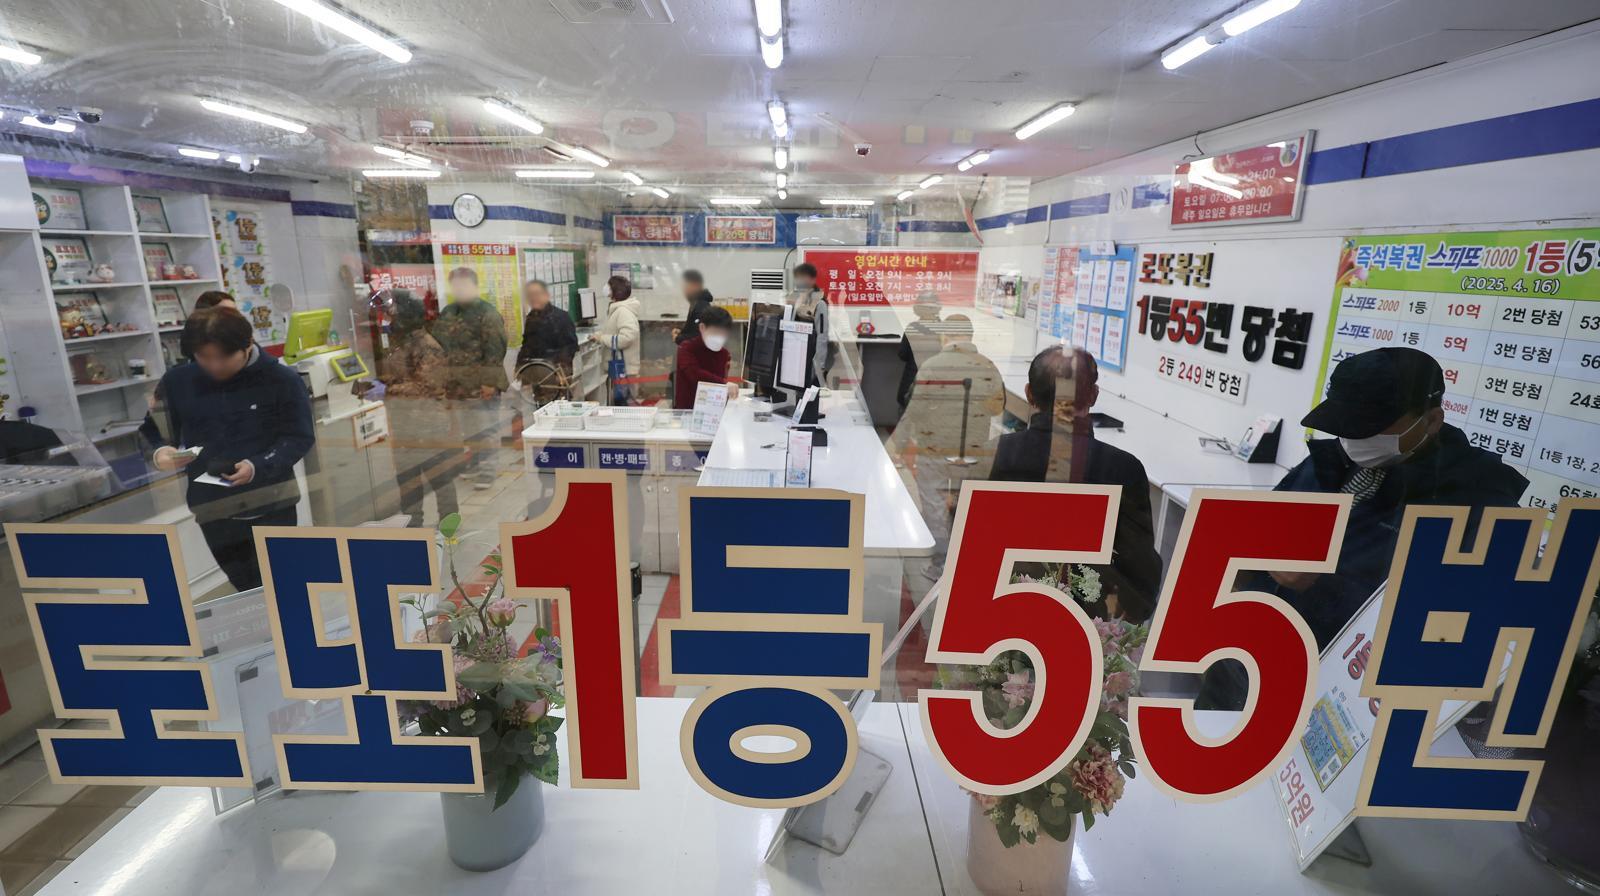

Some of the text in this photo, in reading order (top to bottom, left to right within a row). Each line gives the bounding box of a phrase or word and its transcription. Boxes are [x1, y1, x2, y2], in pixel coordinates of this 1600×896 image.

[1229, 202, 1272, 217] 휴무입니다
[854, 255, 900, 268] 영업시간
[905, 255, 928, 268] 안내
[1355, 243, 1425, 271] 즉석복권
[865, 270, 884, 280] 오전
[887, 270, 902, 280] 9시
[914, 271, 934, 281] 오후
[1138, 252, 1215, 288] 로또복권
[828, 281, 857, 291] 토요일
[865, 281, 884, 291] 오전
[887, 282, 902, 292] 7시
[1461, 276, 1561, 295] (2025. 4. 16)
[1409, 301, 1428, 315] 1등
[1447, 303, 1482, 319] 10억
[1502, 307, 1527, 323] 2번
[1531, 309, 1564, 326] 당첨
[1240, 305, 1314, 371] 당첨
[1402, 331, 1420, 346] 1등
[1443, 336, 1468, 352] 5억
[1493, 343, 1518, 359] 3번
[1521, 346, 1553, 364] 당첨
[1159, 356, 1175, 376] 2등
[1218, 372, 1242, 397] 당첨
[1484, 377, 1508, 394] 3번
[1512, 381, 1543, 400] 당첨
[1479, 407, 1499, 424] 1번
[1502, 411, 1533, 432] 당첨
[567, 452, 578, 464] 이
[1469, 432, 1526, 459] 2번 당첨
[5, 522, 485, 793] 로또
[1279, 757, 1315, 829] 5억원
